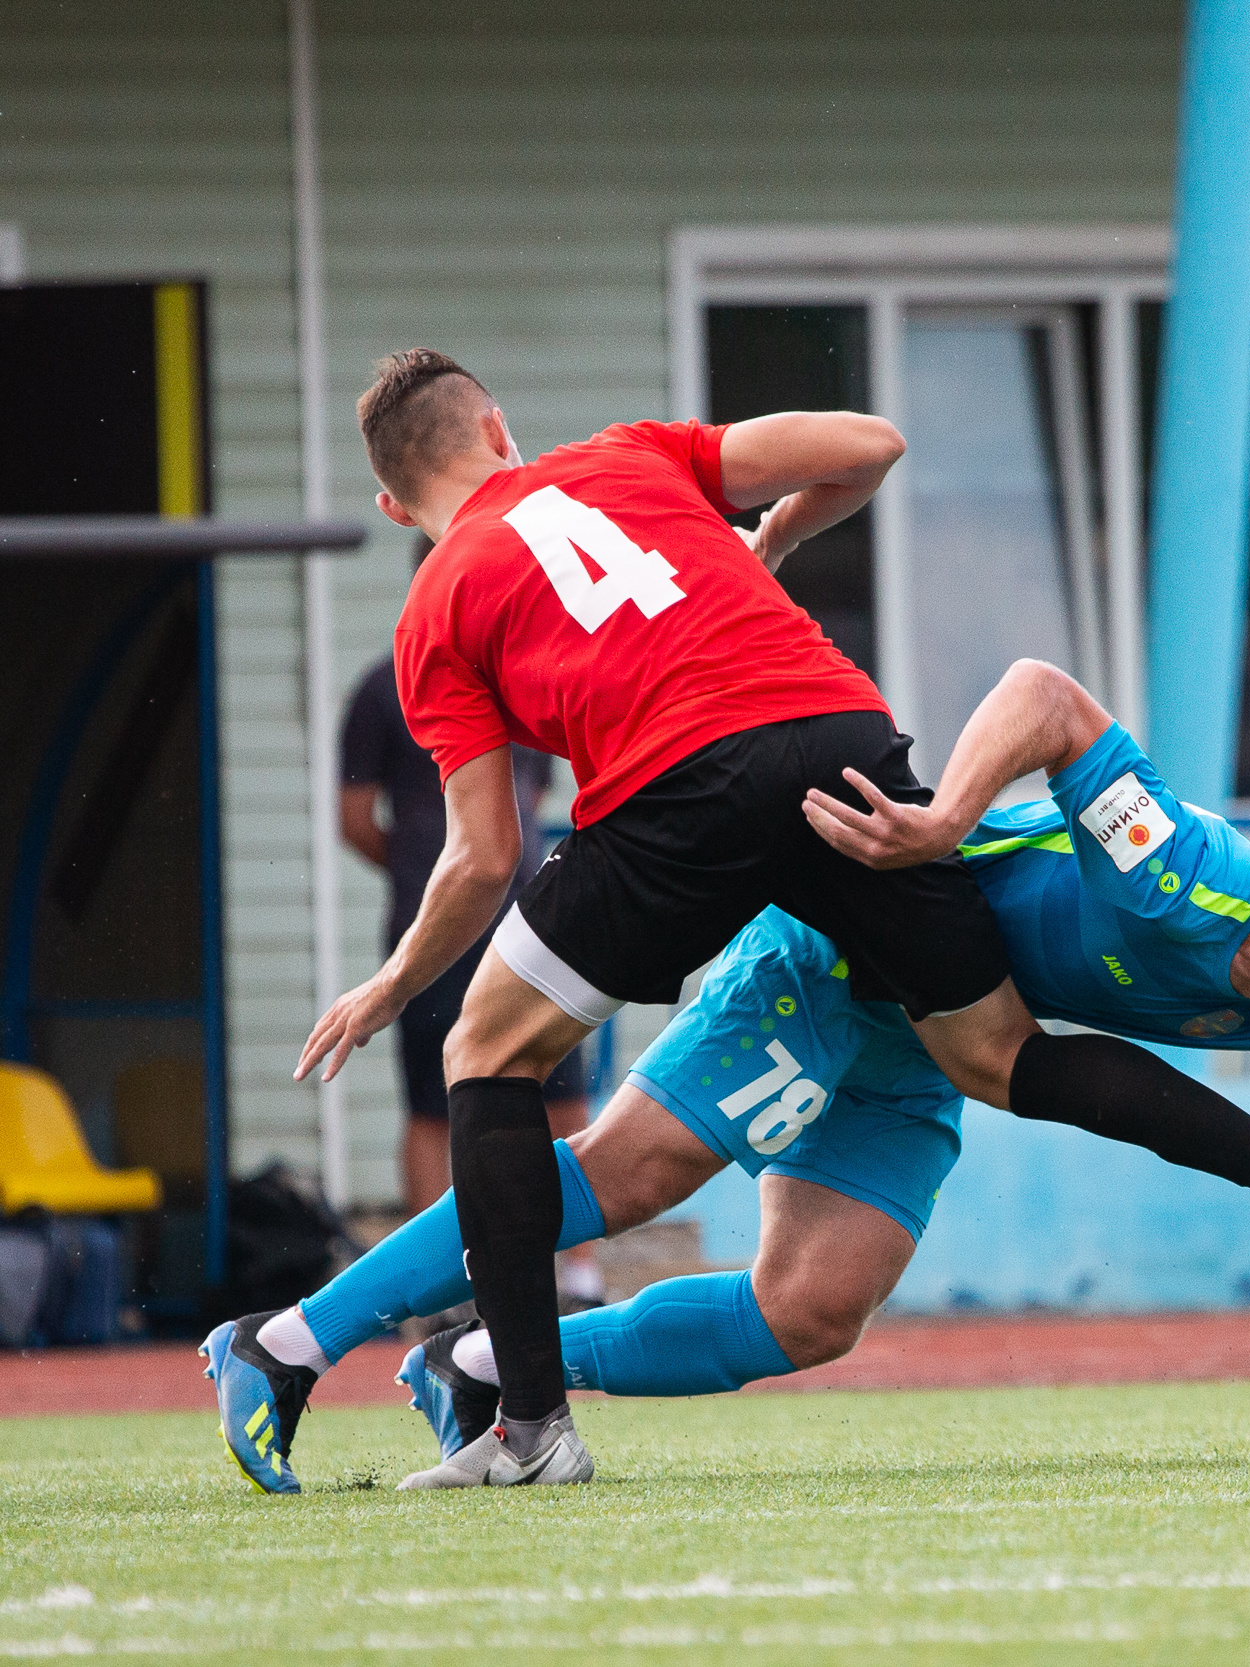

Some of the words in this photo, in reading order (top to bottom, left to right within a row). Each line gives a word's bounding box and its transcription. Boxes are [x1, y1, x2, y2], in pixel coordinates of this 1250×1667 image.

[501, 484, 688, 635] 4
[1097, 795, 1150, 844] ОЛИМП
[1101, 954, 1133, 986] JAKO
[716, 1038, 828, 1155] 78
